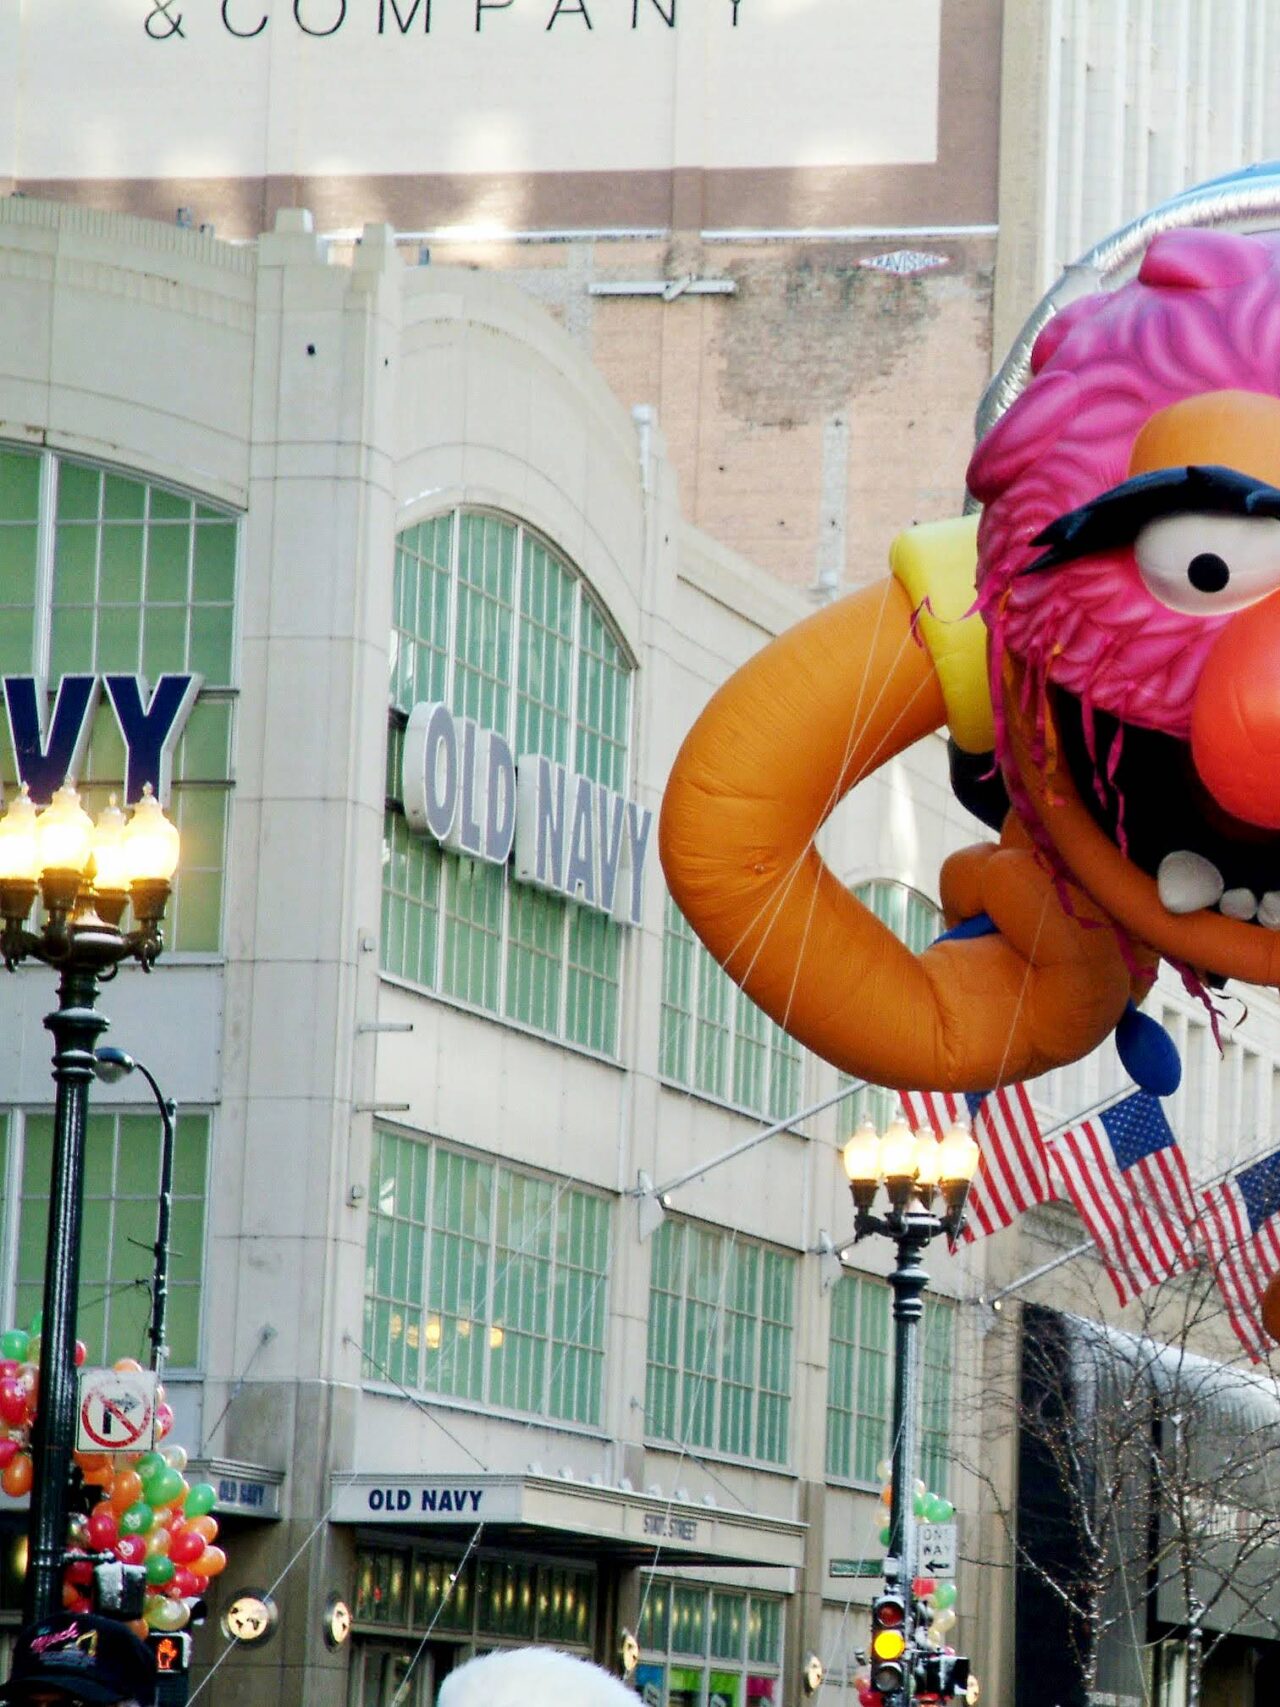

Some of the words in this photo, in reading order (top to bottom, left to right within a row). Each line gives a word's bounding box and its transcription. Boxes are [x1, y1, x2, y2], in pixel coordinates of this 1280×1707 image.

[144, 0, 185, 39] &
[221, 0, 740, 37] COMPANY
[412, 702, 516, 865] OLD
[526, 755, 652, 925] NAVY
[368, 1488, 412, 1512] OLD
[421, 1489, 483, 1512] NAVY
[644, 1513, 667, 1536] STAT
